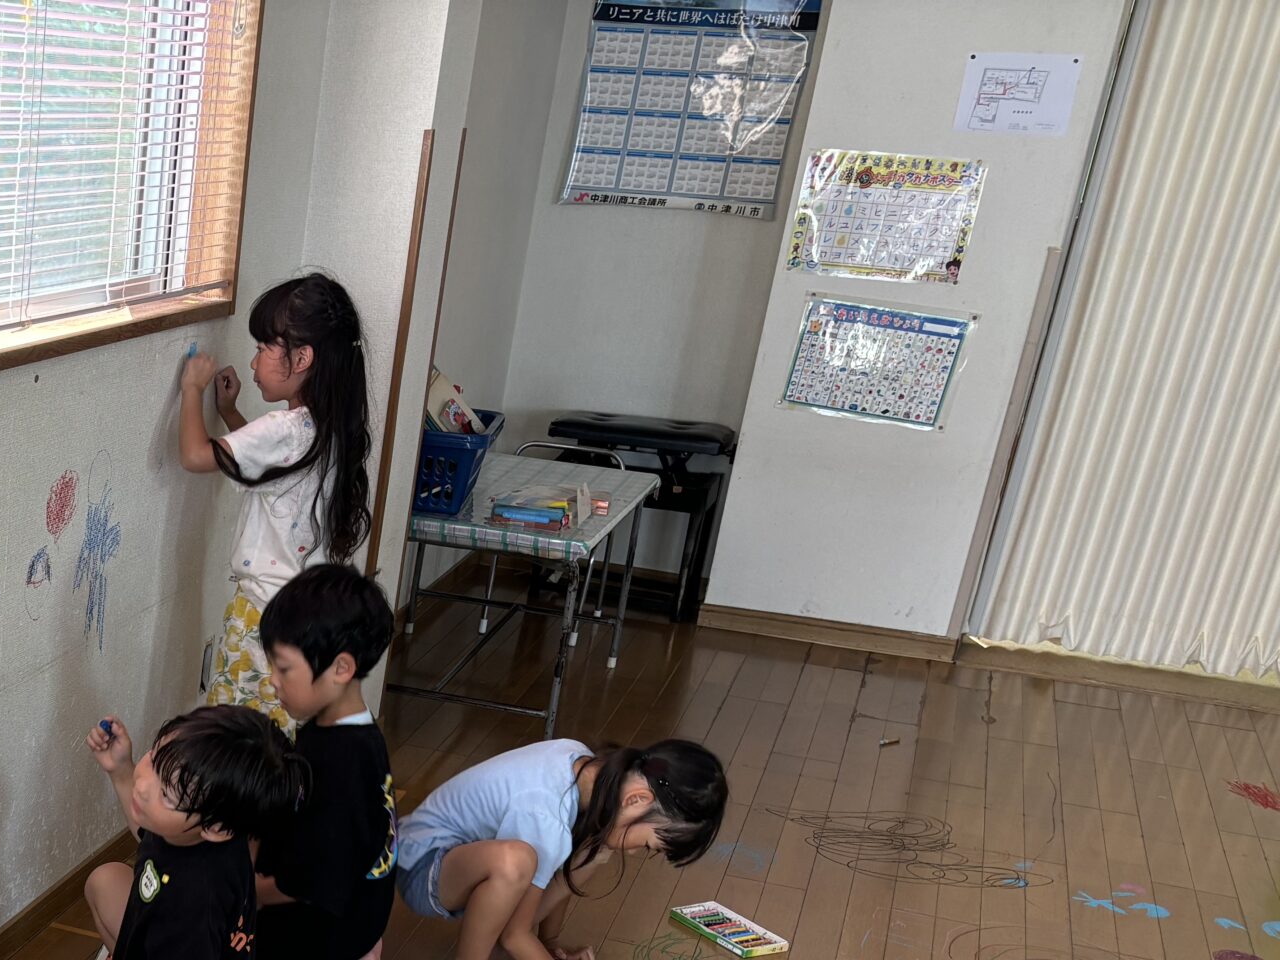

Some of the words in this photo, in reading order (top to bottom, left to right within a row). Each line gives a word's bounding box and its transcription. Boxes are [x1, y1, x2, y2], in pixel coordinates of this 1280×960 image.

[897, 171, 962, 187] カタカナポスター
[590, 193, 668, 207] 中津川商工会議所
[707, 204, 761, 217] 中津川市
